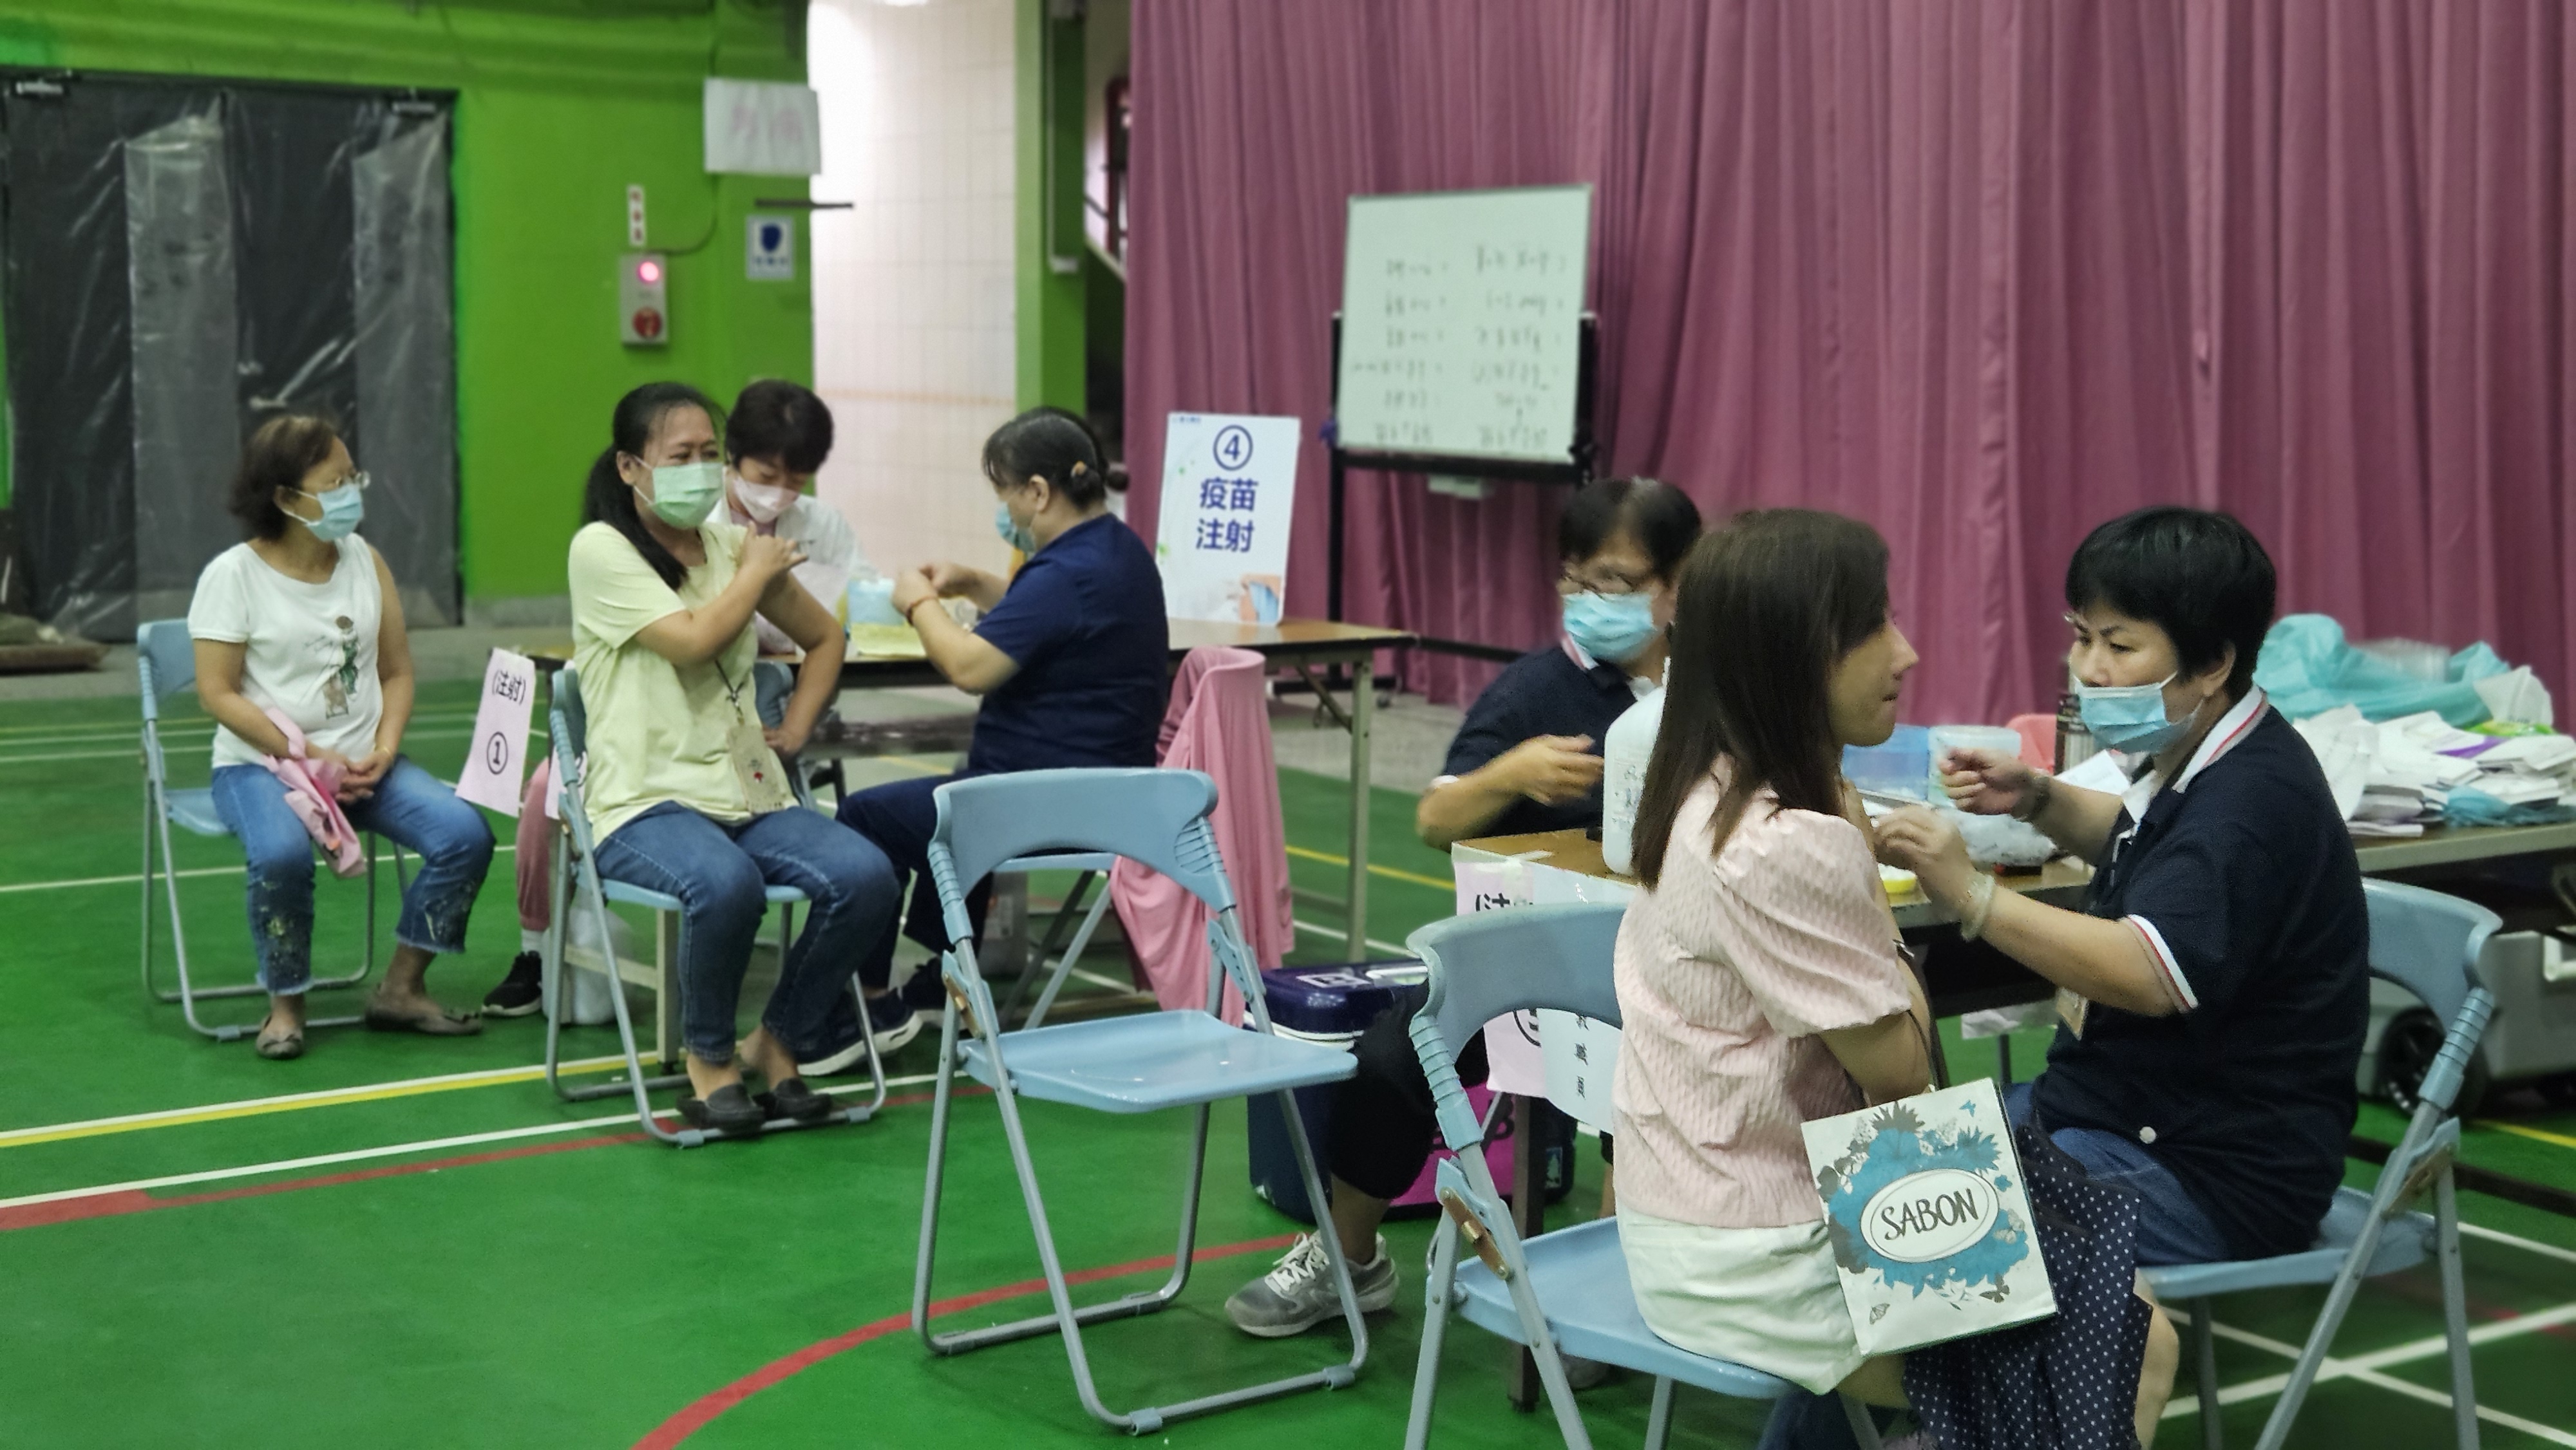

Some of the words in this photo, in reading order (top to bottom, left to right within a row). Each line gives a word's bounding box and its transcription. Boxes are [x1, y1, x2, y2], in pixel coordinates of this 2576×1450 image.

[1200, 477, 1258, 511] 疫苗
[1196, 518, 1255, 552] 注射
[1880, 1187, 1979, 1241] SABON
